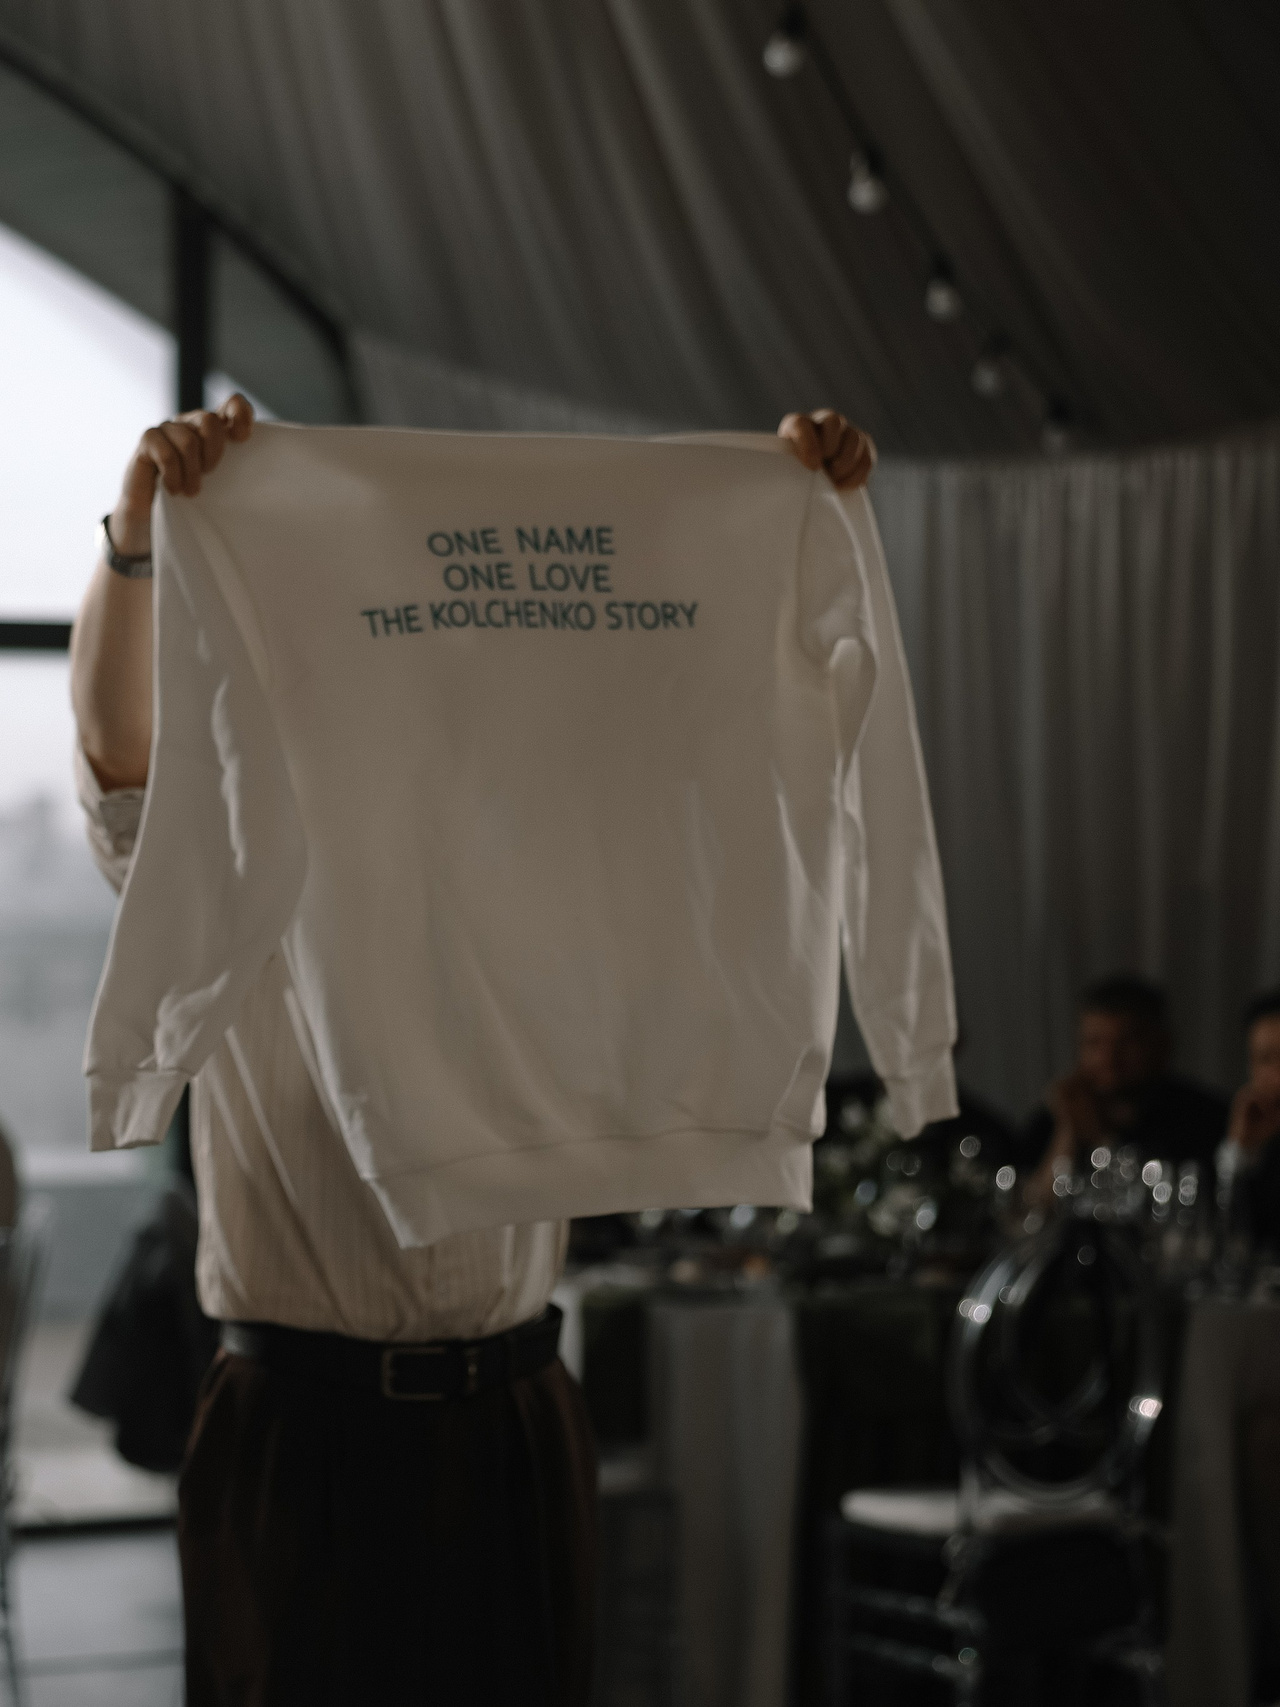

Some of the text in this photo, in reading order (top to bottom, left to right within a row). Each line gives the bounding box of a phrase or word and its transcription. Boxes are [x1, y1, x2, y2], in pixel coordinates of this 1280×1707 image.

[426, 525, 616, 557] ONE NAME
[443, 562, 613, 593] ONE LOVE
[361, 599, 699, 638] THE KOLCHENKO STORY
